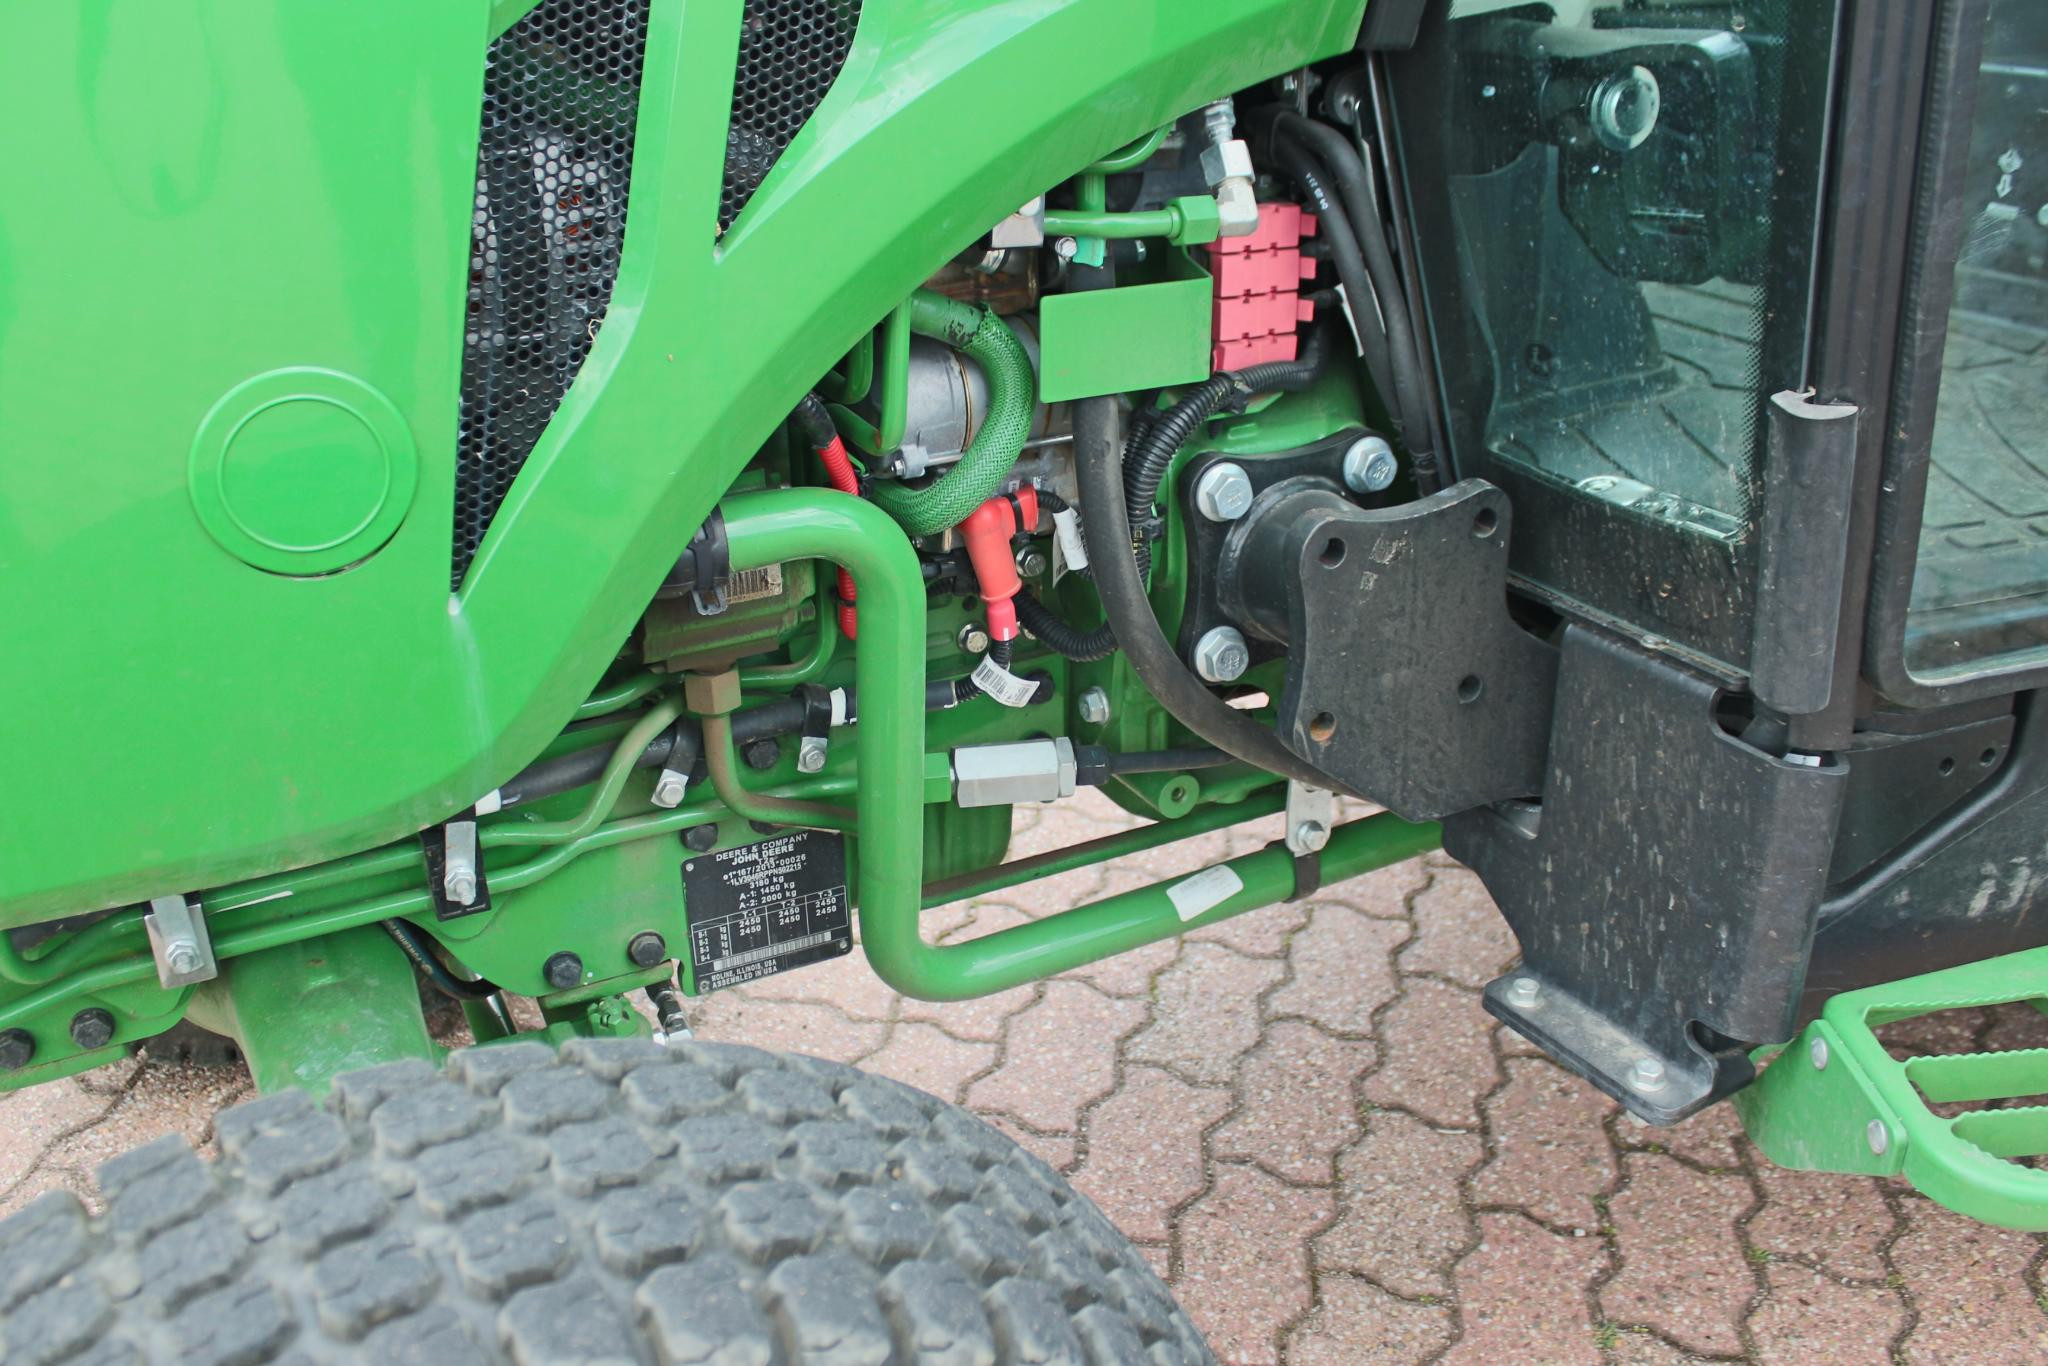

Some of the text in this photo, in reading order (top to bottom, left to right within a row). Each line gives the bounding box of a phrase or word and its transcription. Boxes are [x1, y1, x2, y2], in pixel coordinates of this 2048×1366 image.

[716, 848, 748, 862] DEERE
[762, 833, 808, 850] COMPANY
[732, 844, 794, 866] JOHN DEERE
[740, 890, 757, 901] A-1:
[760, 884, 780, 894] 1450
[750, 878, 769, 888] 3180
[739, 900, 758, 909] A-2:
[761, 893, 782, 903] 2000
[739, 917, 760, 928] 2450
[778, 907, 799, 917] 2450
[816, 898, 836, 908] 2450
[739, 925, 761, 936] 2450
[779, 915, 800, 925] 2450
[816, 906, 836, 916] 2450
[712, 970, 735, 982] MOLINE,
[736, 963, 763, 974] ILLINOIS,
[712, 974, 753, 988] ASSEMBLED
